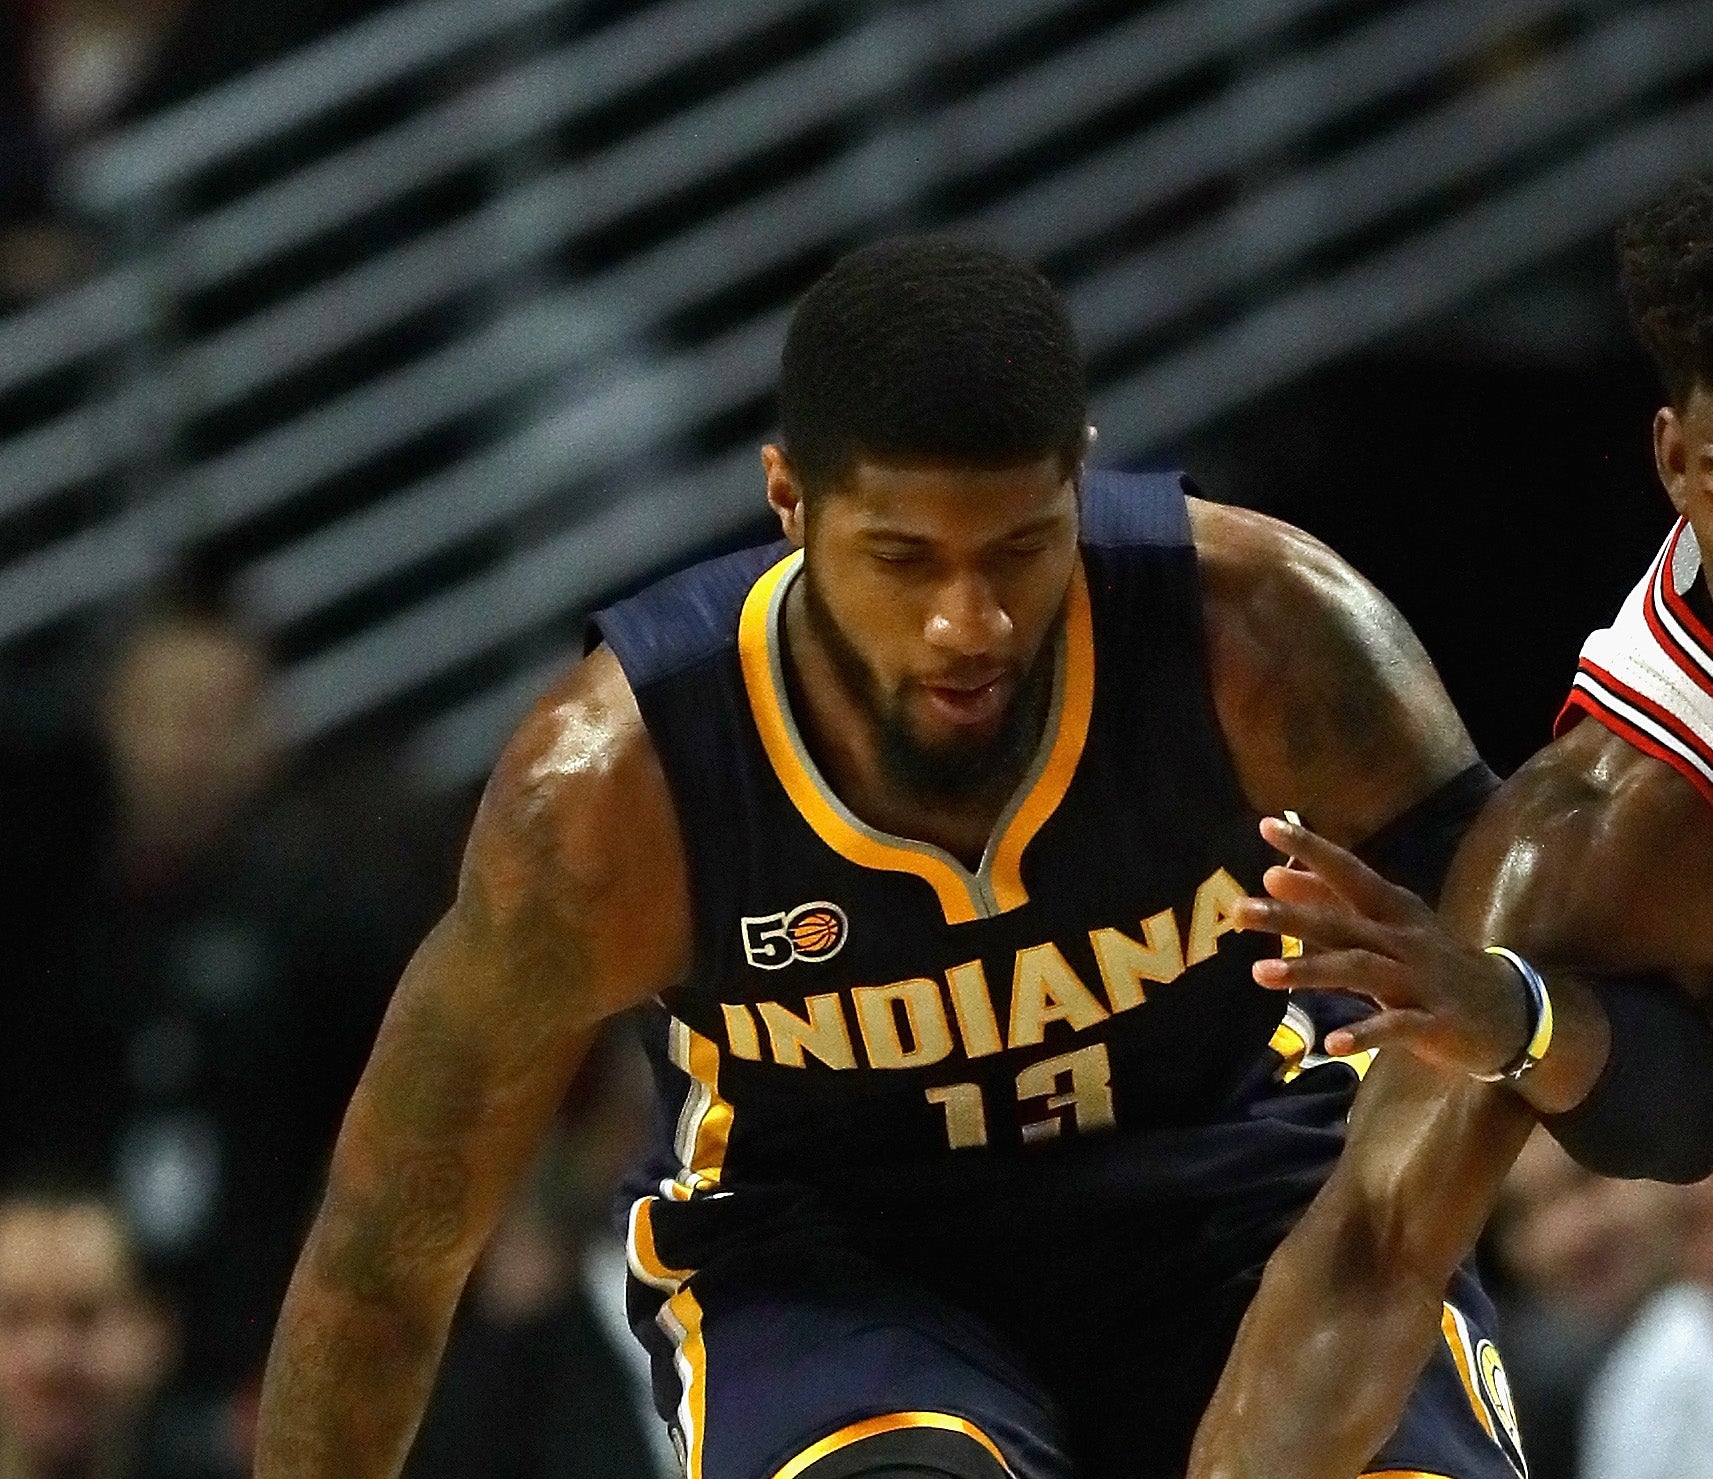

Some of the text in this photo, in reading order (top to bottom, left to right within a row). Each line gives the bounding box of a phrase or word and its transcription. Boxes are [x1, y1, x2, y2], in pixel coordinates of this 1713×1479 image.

[720, 865, 1250, 1071] INDIANA
[740, 900, 849, 971] 50
[924, 1042, 1118, 1150] 13
